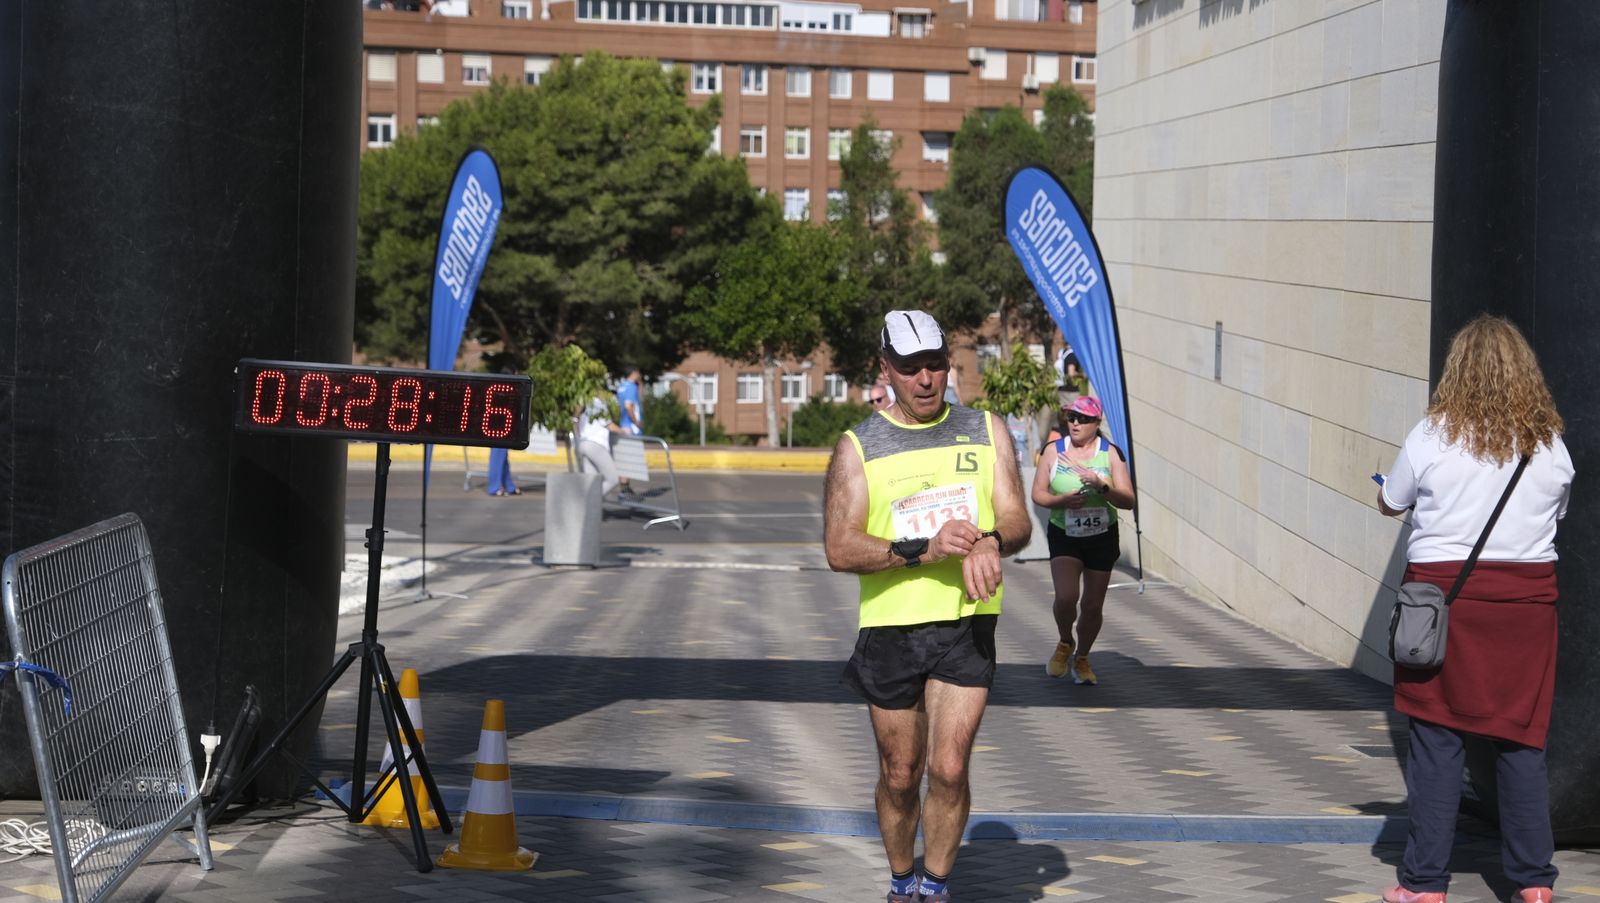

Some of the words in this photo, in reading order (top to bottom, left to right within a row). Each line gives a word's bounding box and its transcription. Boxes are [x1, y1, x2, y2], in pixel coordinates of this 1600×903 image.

[252, 370, 514, 438] 00:28:16
[955, 451, 978, 472] LS
[907, 504, 972, 533] 1133
[1074, 516, 1101, 527] 145
